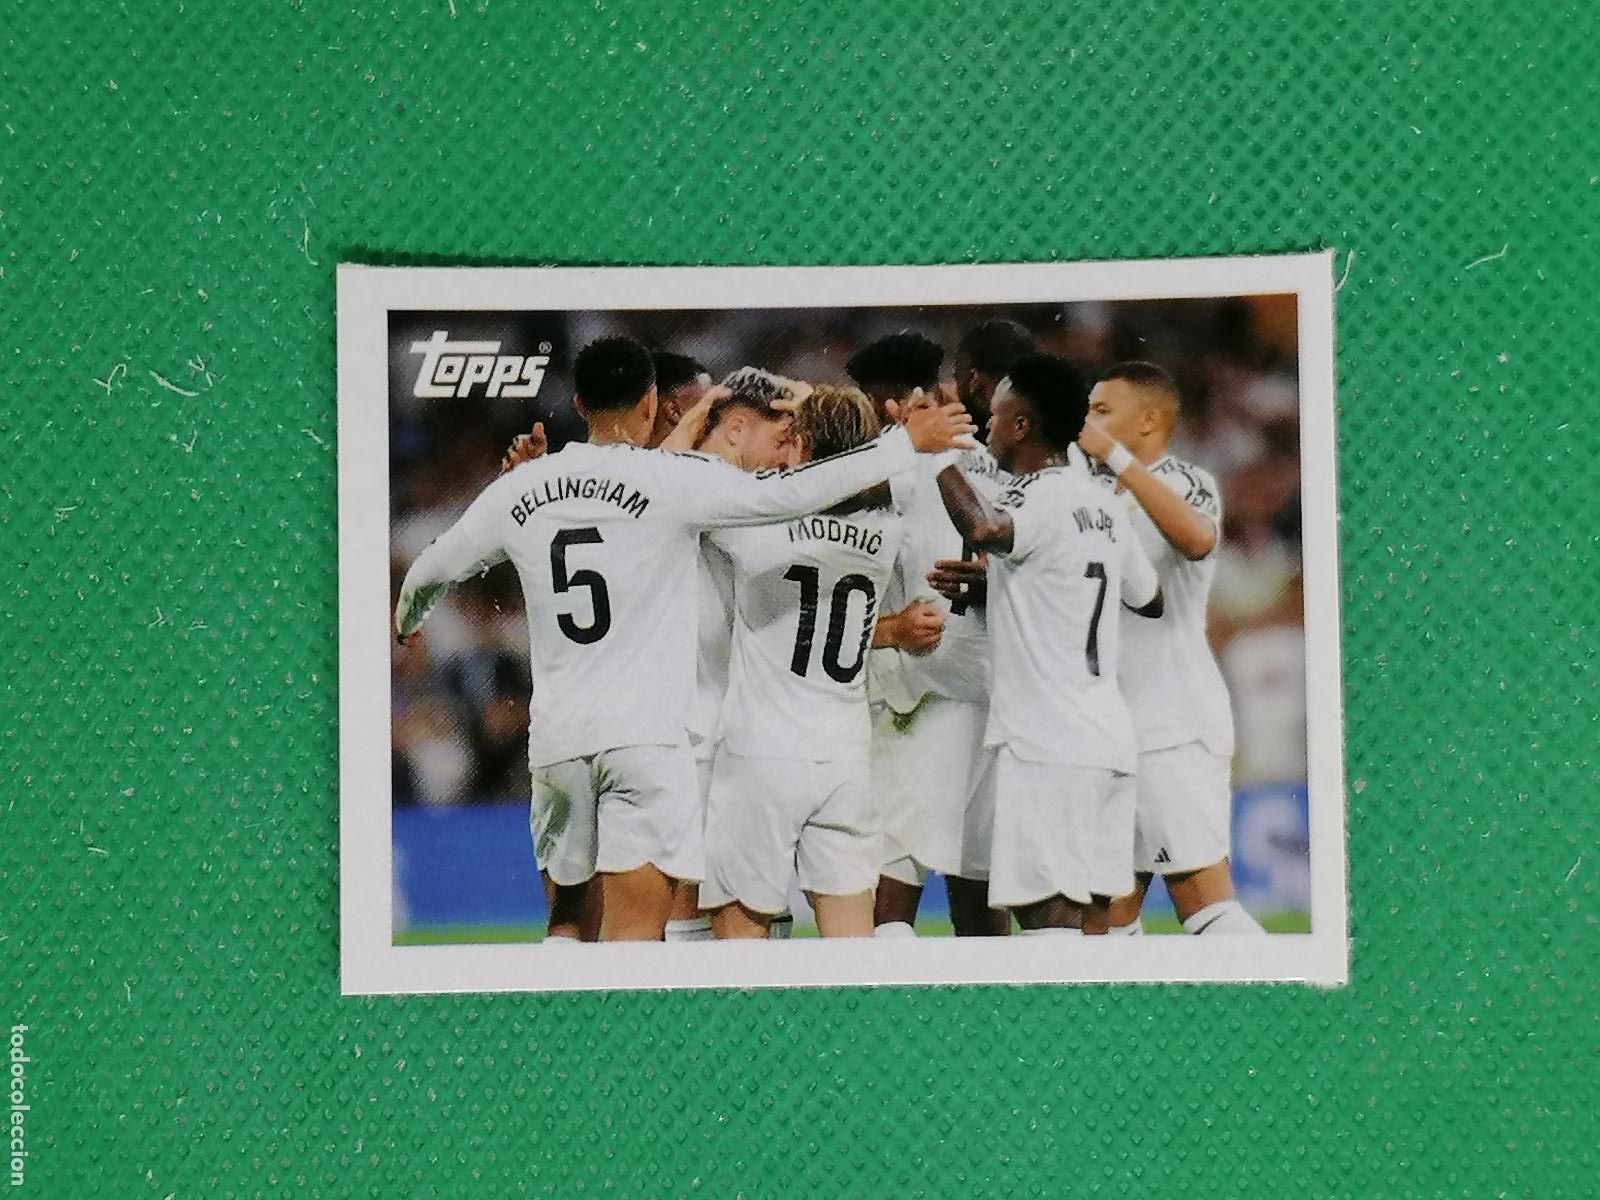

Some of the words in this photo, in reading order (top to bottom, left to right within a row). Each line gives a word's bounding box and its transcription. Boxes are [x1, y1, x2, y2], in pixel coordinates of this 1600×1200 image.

[511, 477, 650, 526] BELLINGHAM
[550, 526, 611, 645] 5
[782, 564, 877, 683] 10
[1084, 561, 1107, 677] 7
